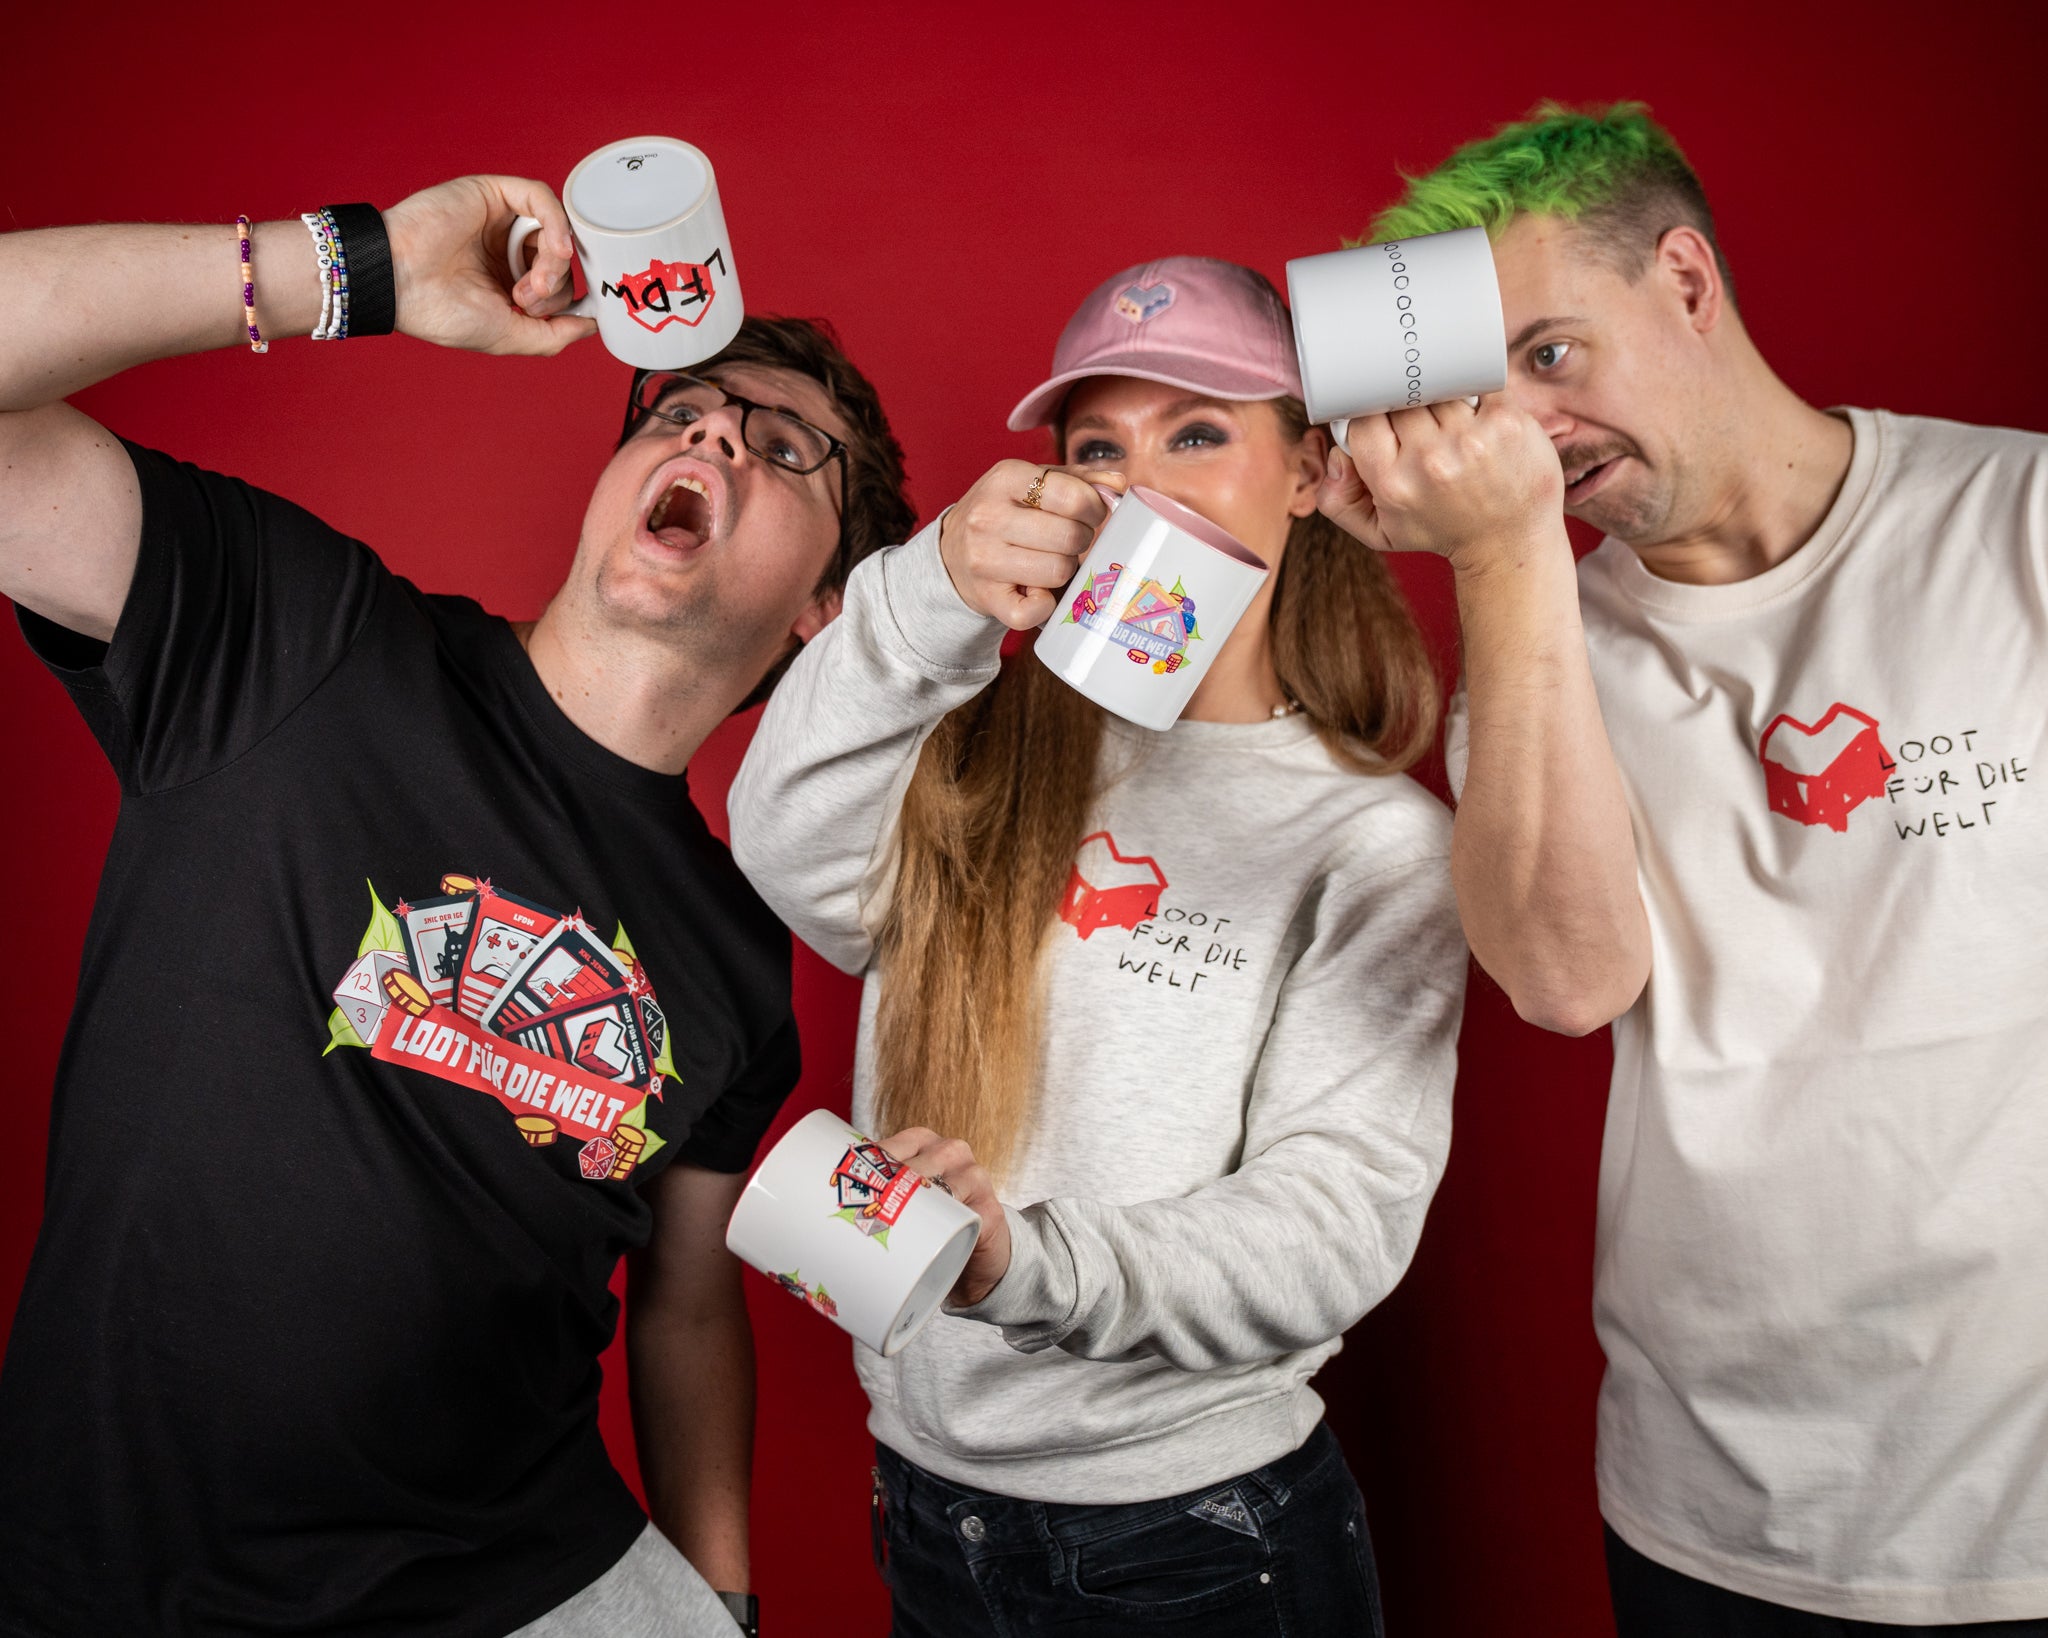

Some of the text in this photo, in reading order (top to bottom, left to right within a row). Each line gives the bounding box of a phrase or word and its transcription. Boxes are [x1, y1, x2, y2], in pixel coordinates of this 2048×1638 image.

[1127, 631, 1147, 650] DIE
[1144, 637, 1175, 658] WELT
[1878, 730, 1978, 770] LOOT
[1886, 757, 2028, 804] FÜR DIE
[1894, 801, 1998, 840] WELT
[513, 913, 536, 927] LFDW
[1143, 902, 1231, 935] LOOT
[1132, 923, 1248, 970] FÜR DIE
[351, 972, 373, 994] 12
[1118, 951, 1208, 993] WELT
[356, 1007, 367, 1024] 3
[621, 1003, 647, 1076] LOOT FÜR DIE WELT
[391, 1014, 626, 1132] LOOT FÜR DIE WELT
[880, 1190, 905, 1220] LOOT
[1202, 1499, 1246, 1523] REPLAY
